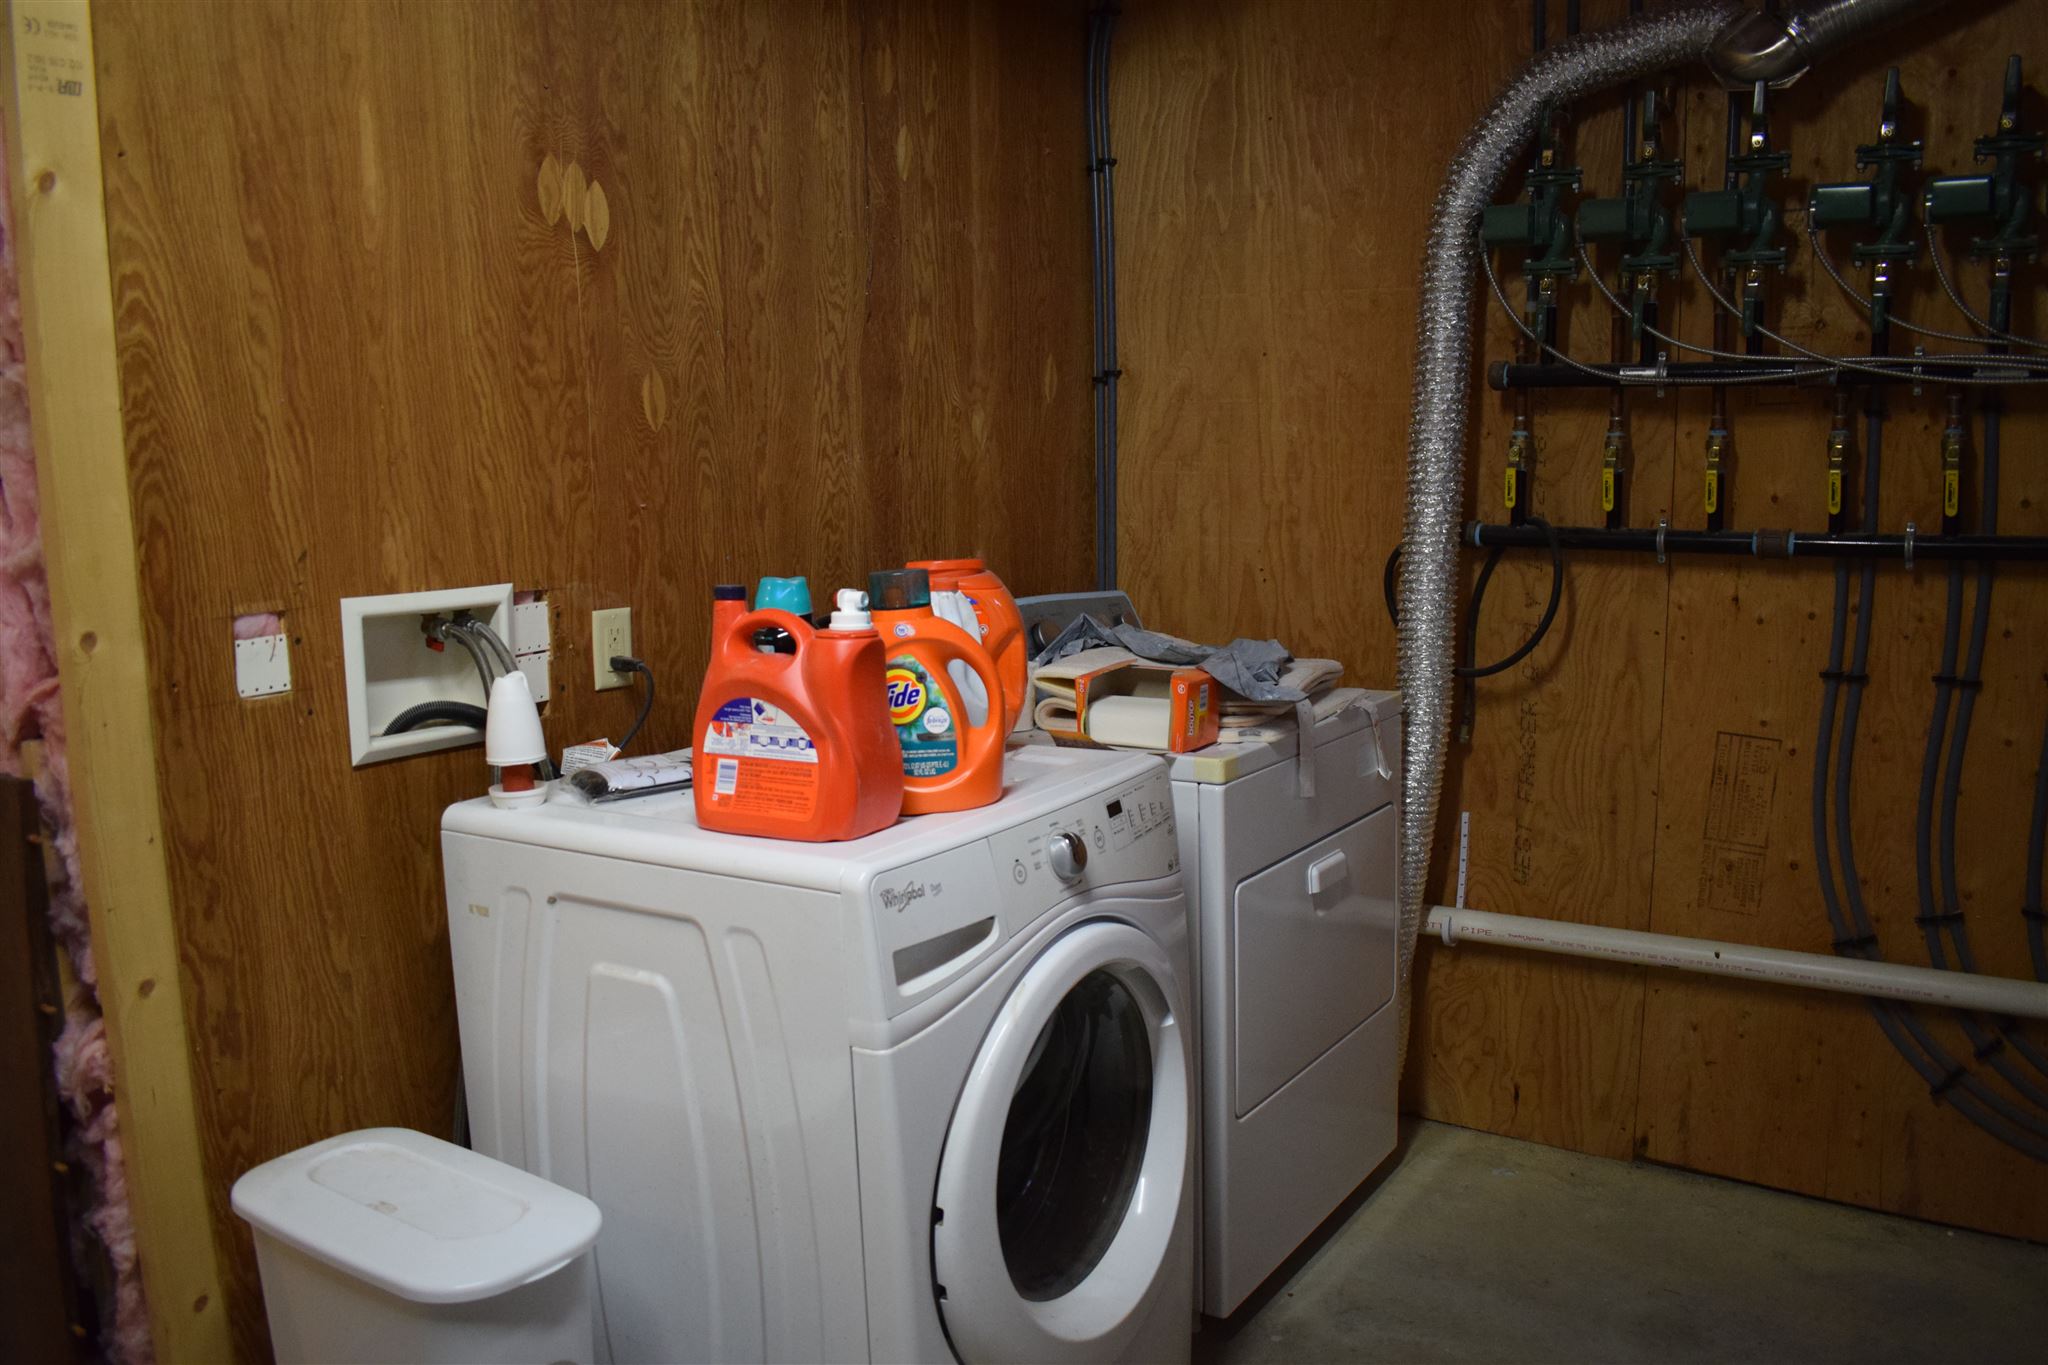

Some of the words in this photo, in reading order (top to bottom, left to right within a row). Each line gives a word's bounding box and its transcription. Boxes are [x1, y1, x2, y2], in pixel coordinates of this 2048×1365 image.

[1187, 699, 1196, 737] bounce
[880, 880, 926, 913] Whirlpool
[1461, 926, 1493, 937] PIPE
